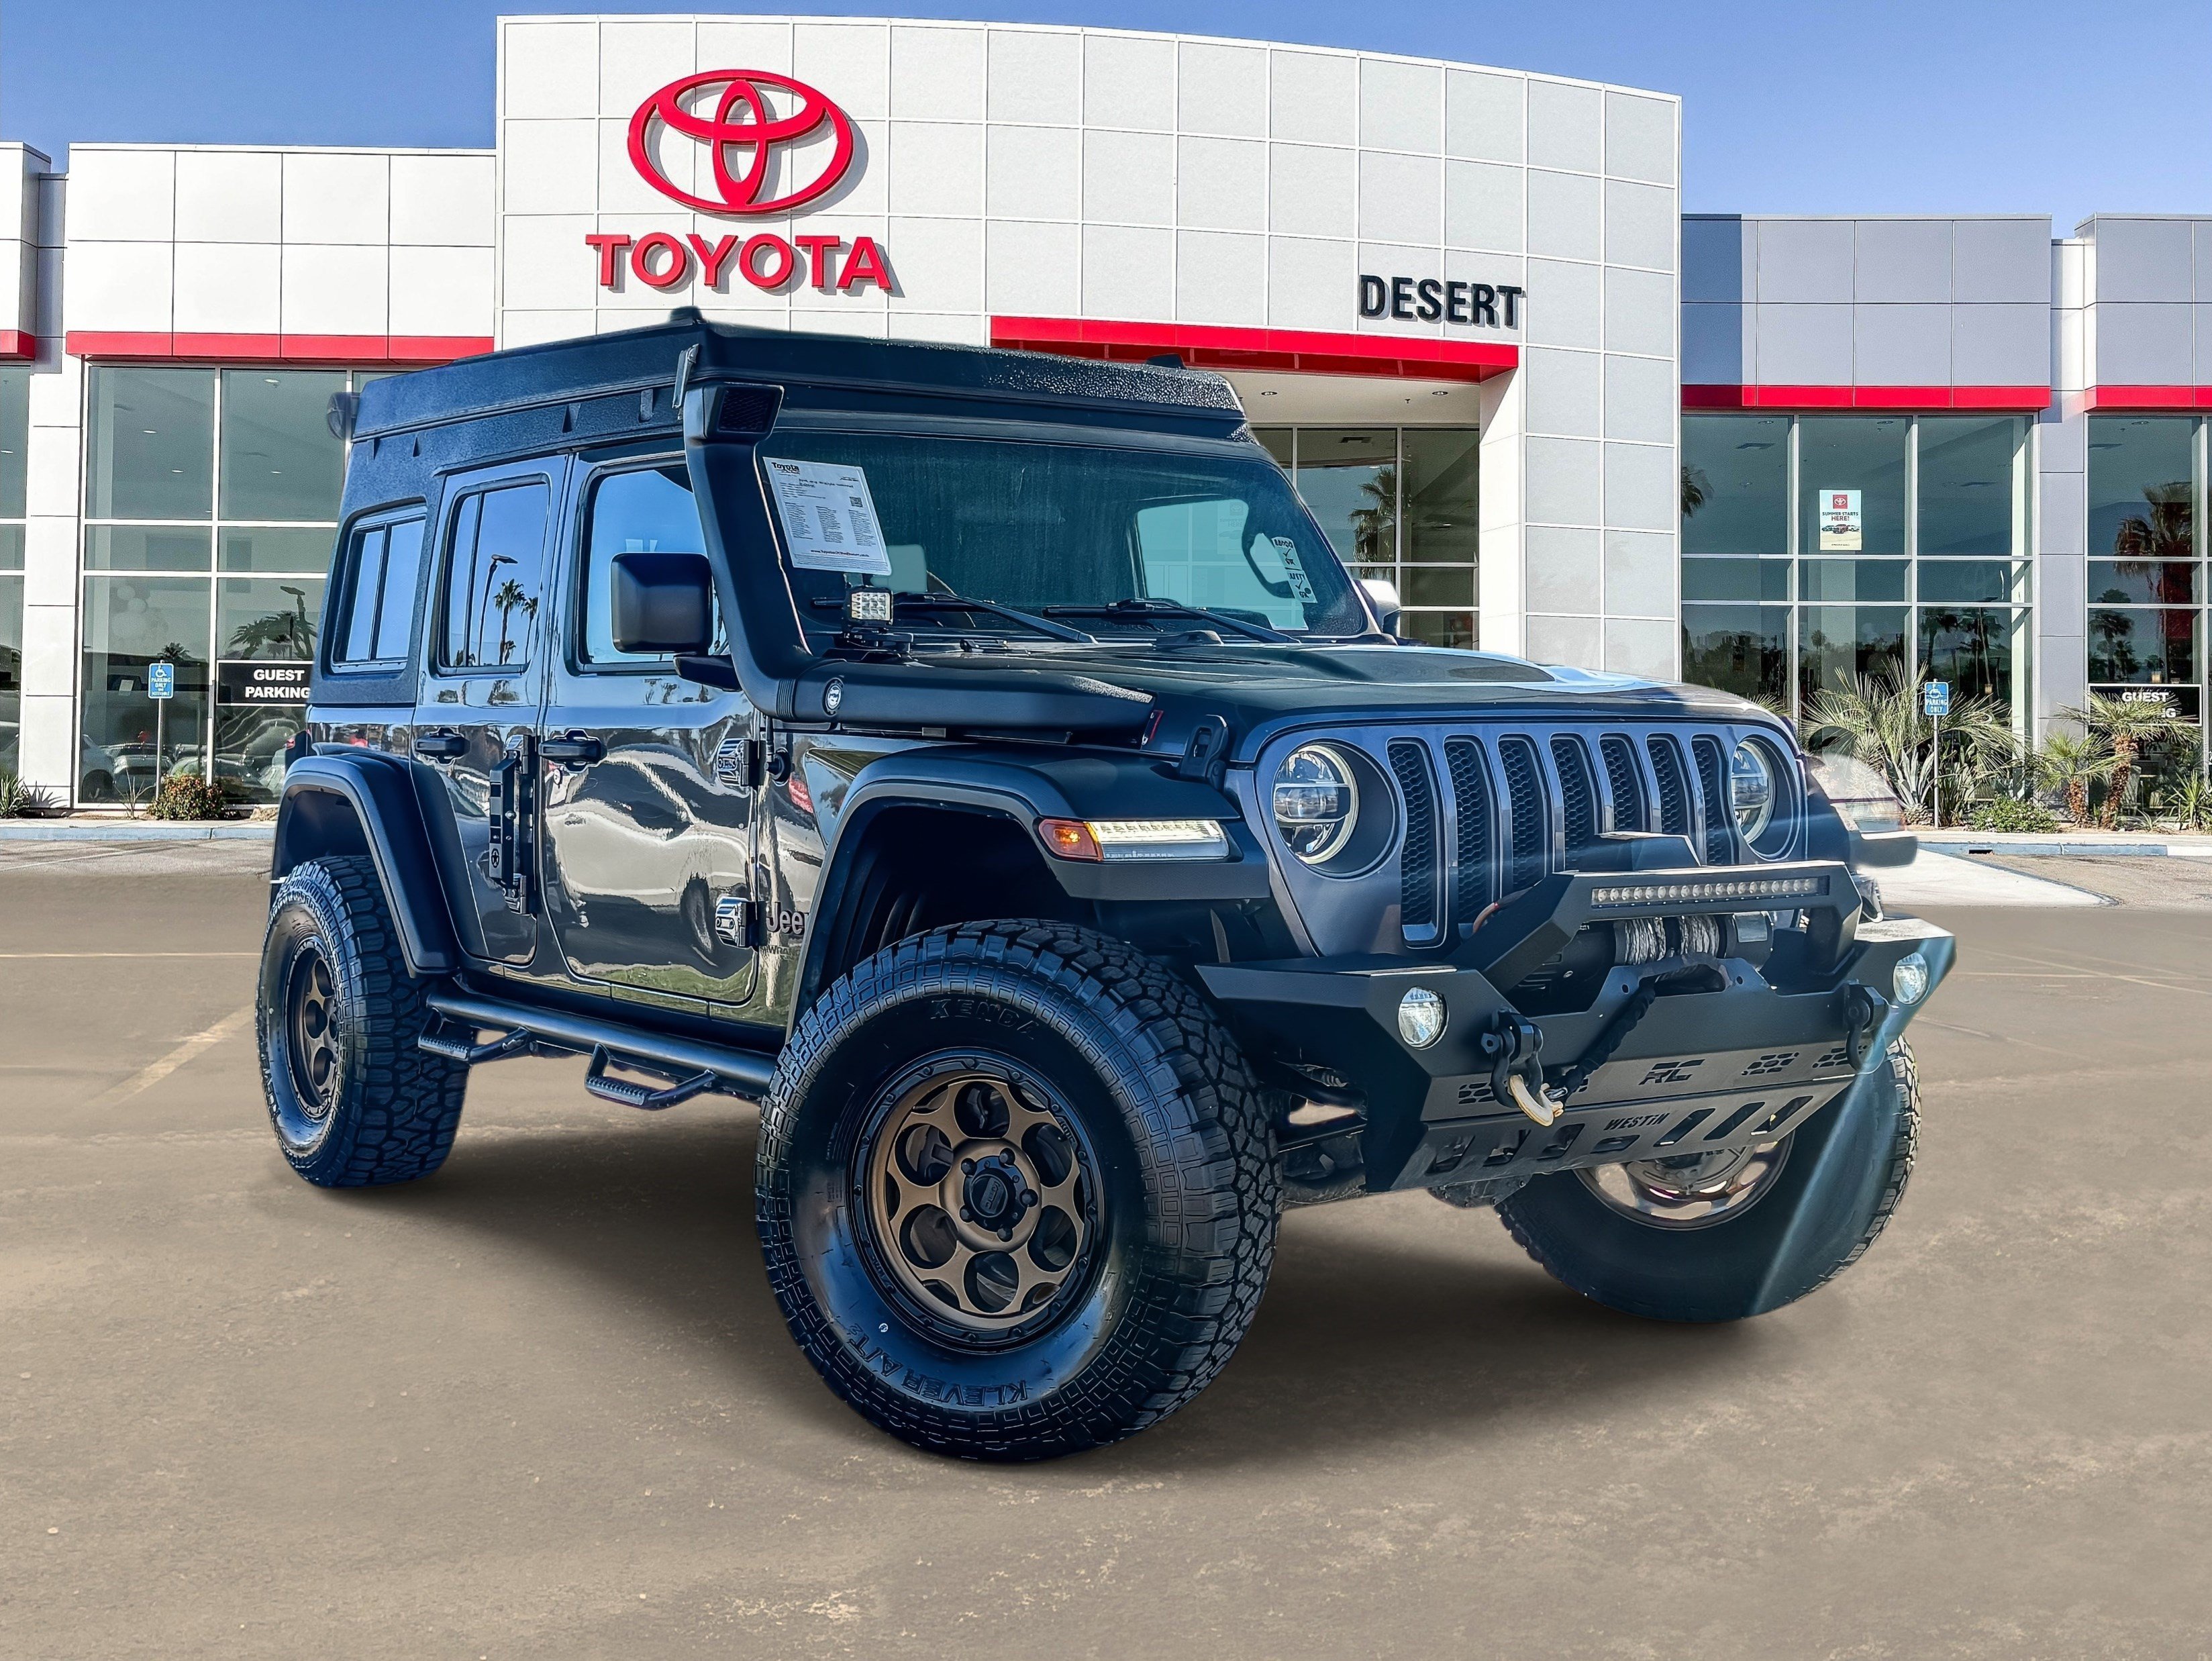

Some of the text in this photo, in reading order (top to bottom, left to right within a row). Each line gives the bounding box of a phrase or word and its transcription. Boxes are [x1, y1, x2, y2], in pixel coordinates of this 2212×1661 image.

[585, 232, 892, 290] TOYOTA
[1359, 274, 1522, 327] DESERT
[245, 686, 311, 699] PARKING
[253, 668, 305, 681] GUEST
[2121, 691, 2169, 703] GUEST
[766, 901, 809, 936] Jee
[930, 999, 1040, 1040] KENDA
[902, 1368, 1028, 1406] KLEVER
